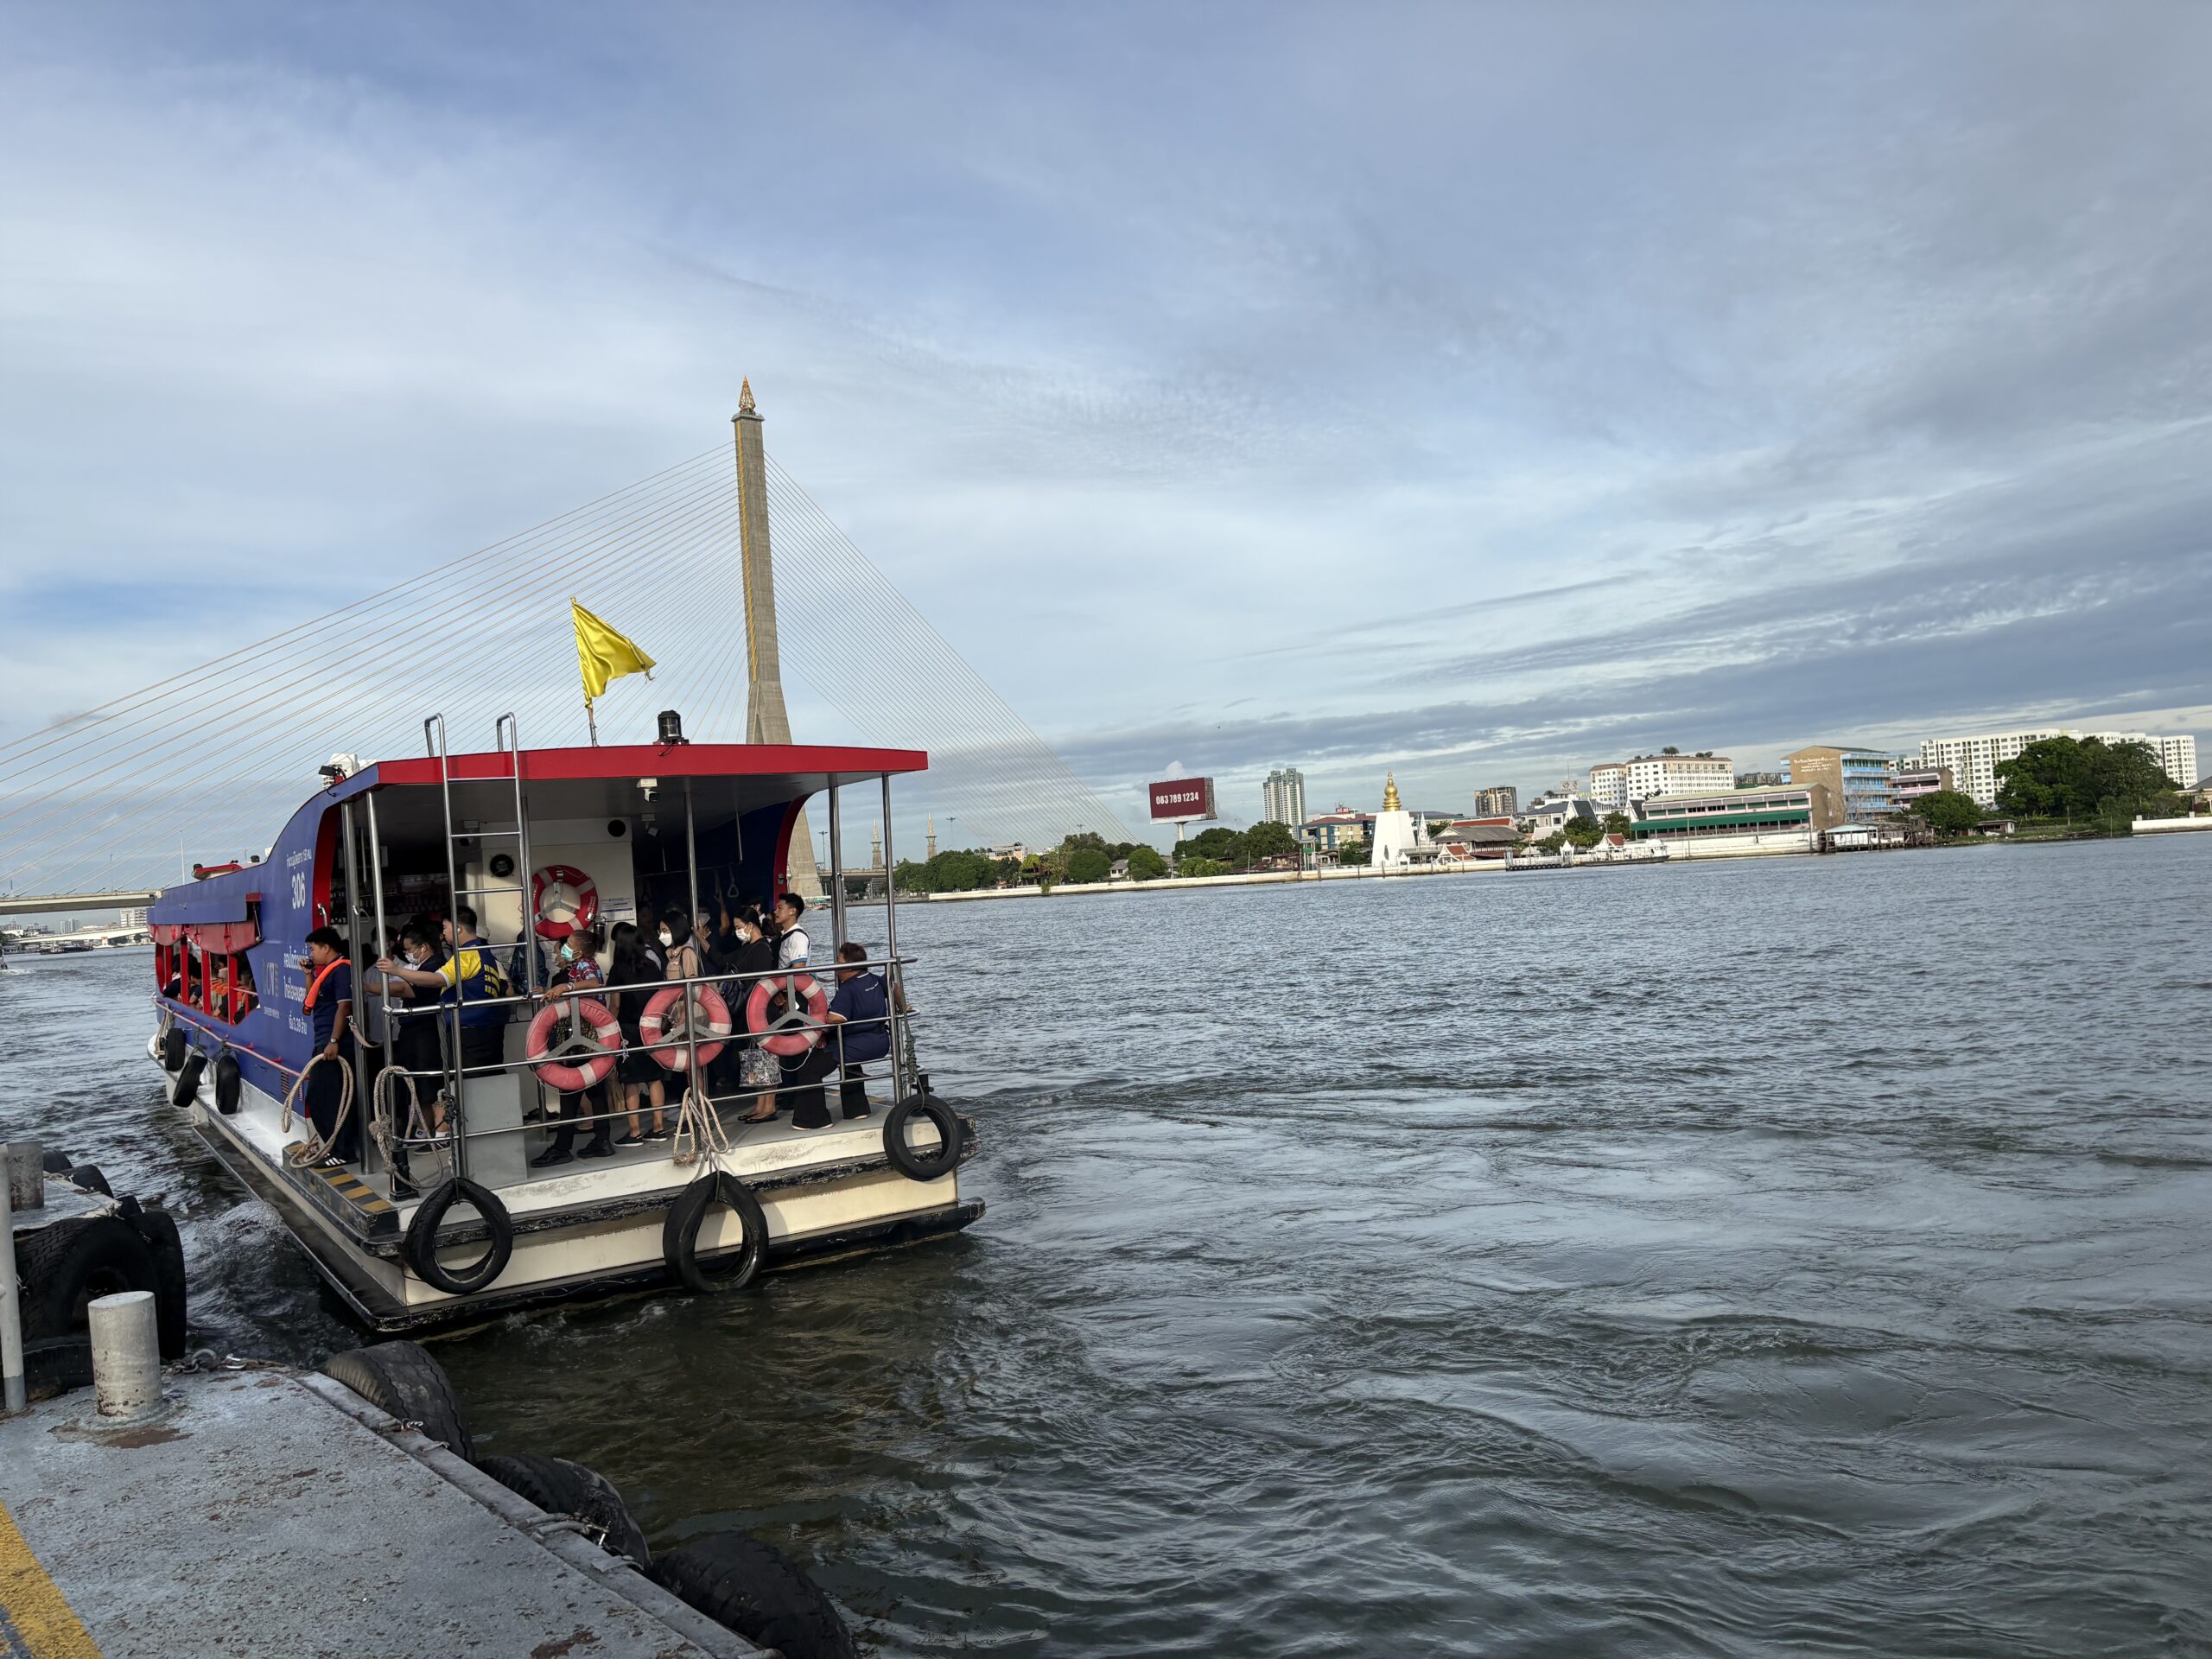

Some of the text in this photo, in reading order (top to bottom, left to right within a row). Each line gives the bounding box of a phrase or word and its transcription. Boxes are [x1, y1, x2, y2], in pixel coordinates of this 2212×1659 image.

[1155, 791, 1199, 804] 083 789 1234
[291, 871, 306, 910] 306
